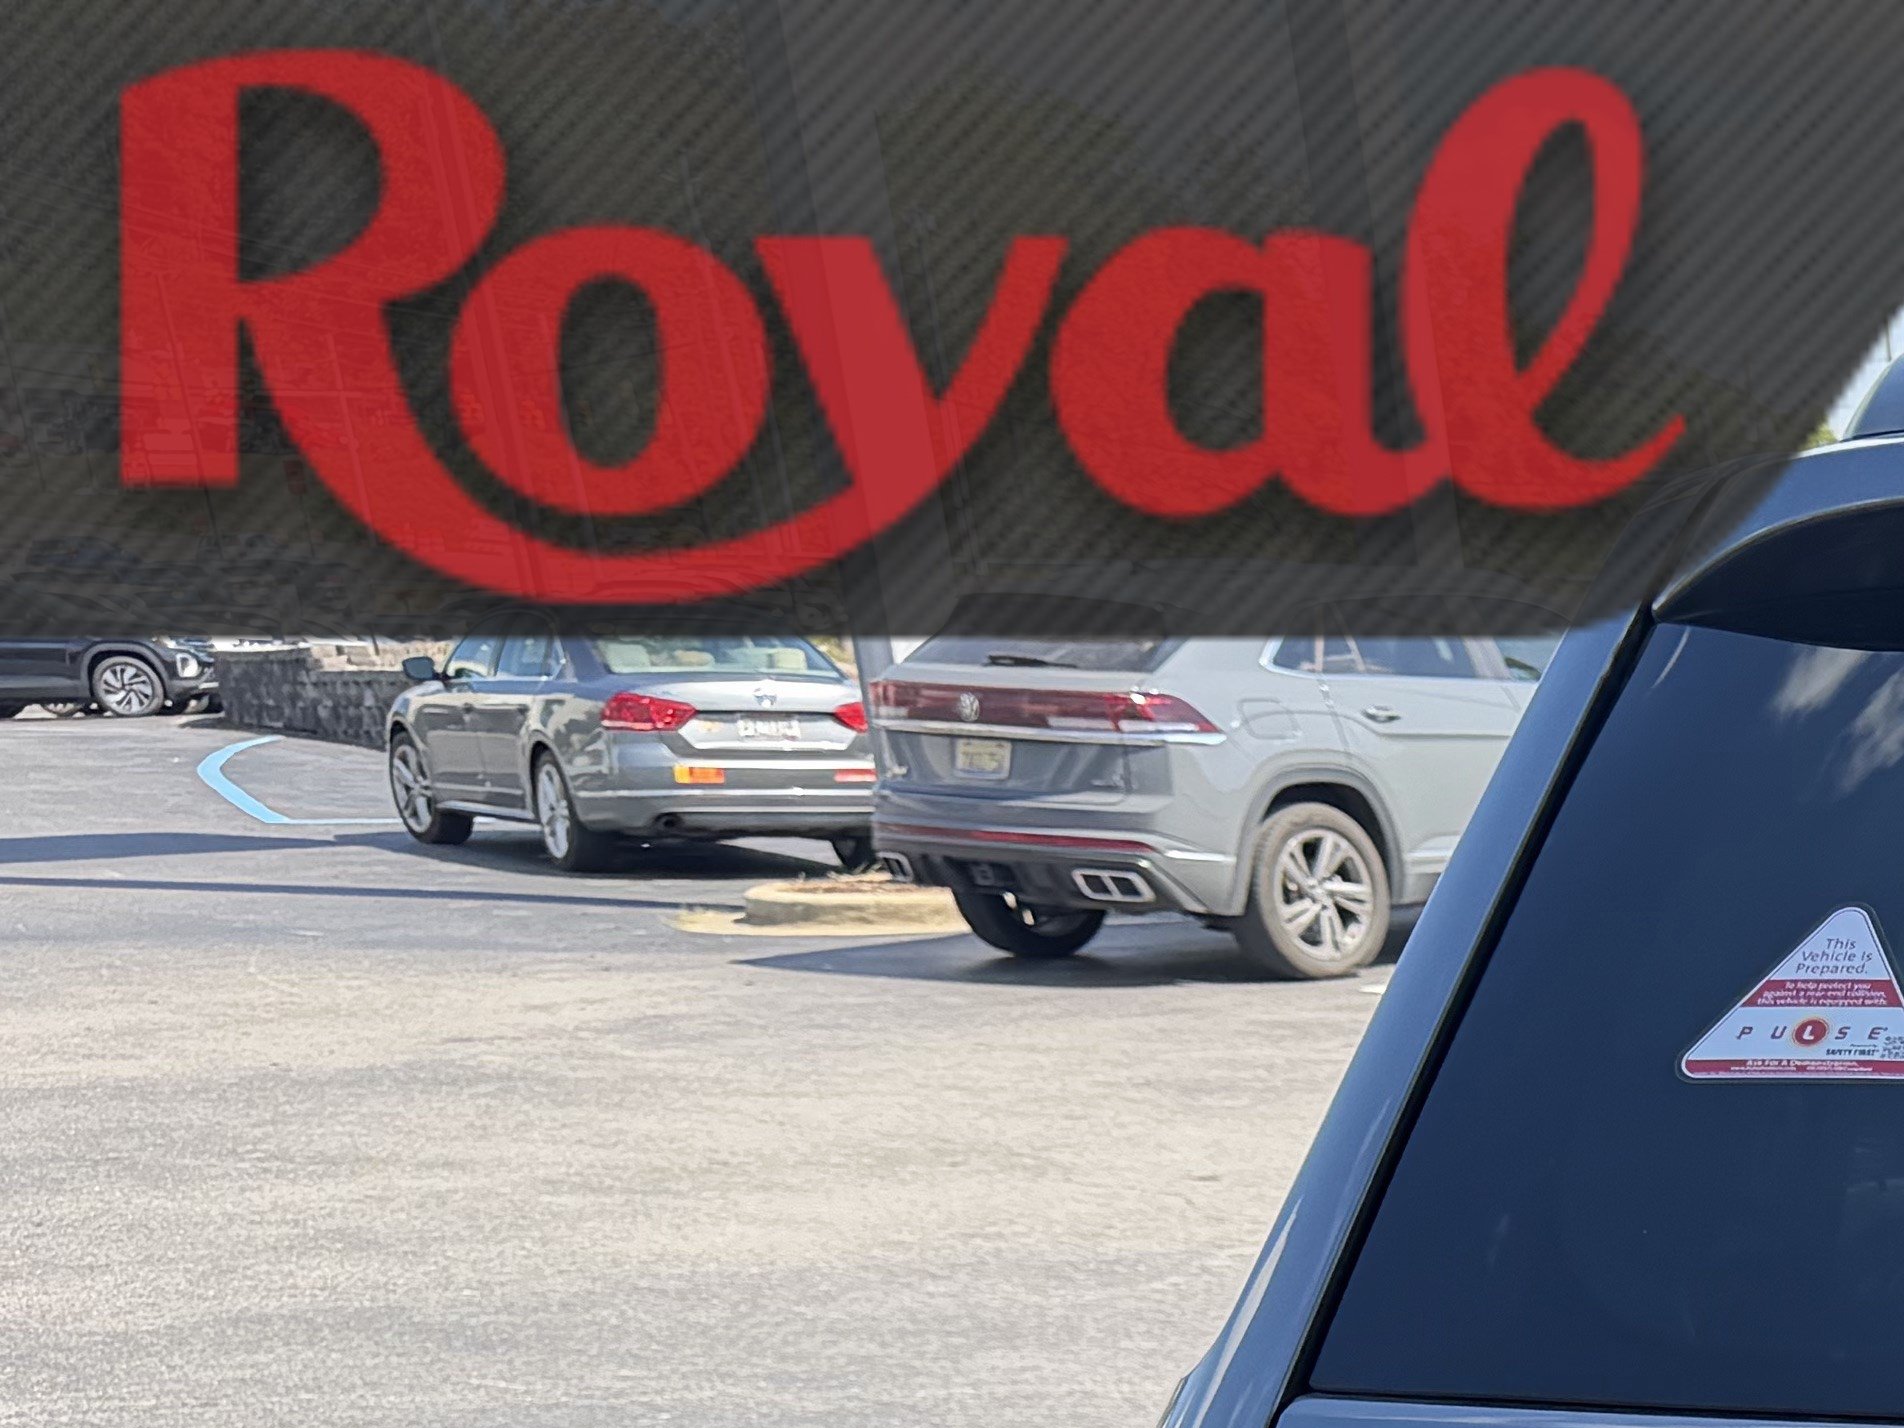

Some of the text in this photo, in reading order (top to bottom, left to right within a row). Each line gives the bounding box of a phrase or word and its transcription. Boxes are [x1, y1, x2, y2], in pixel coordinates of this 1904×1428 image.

[1827, 938, 1857, 950] This
[1802, 950, 1857, 962] Vehicle
[1795, 962, 1868, 976] Prepared.
